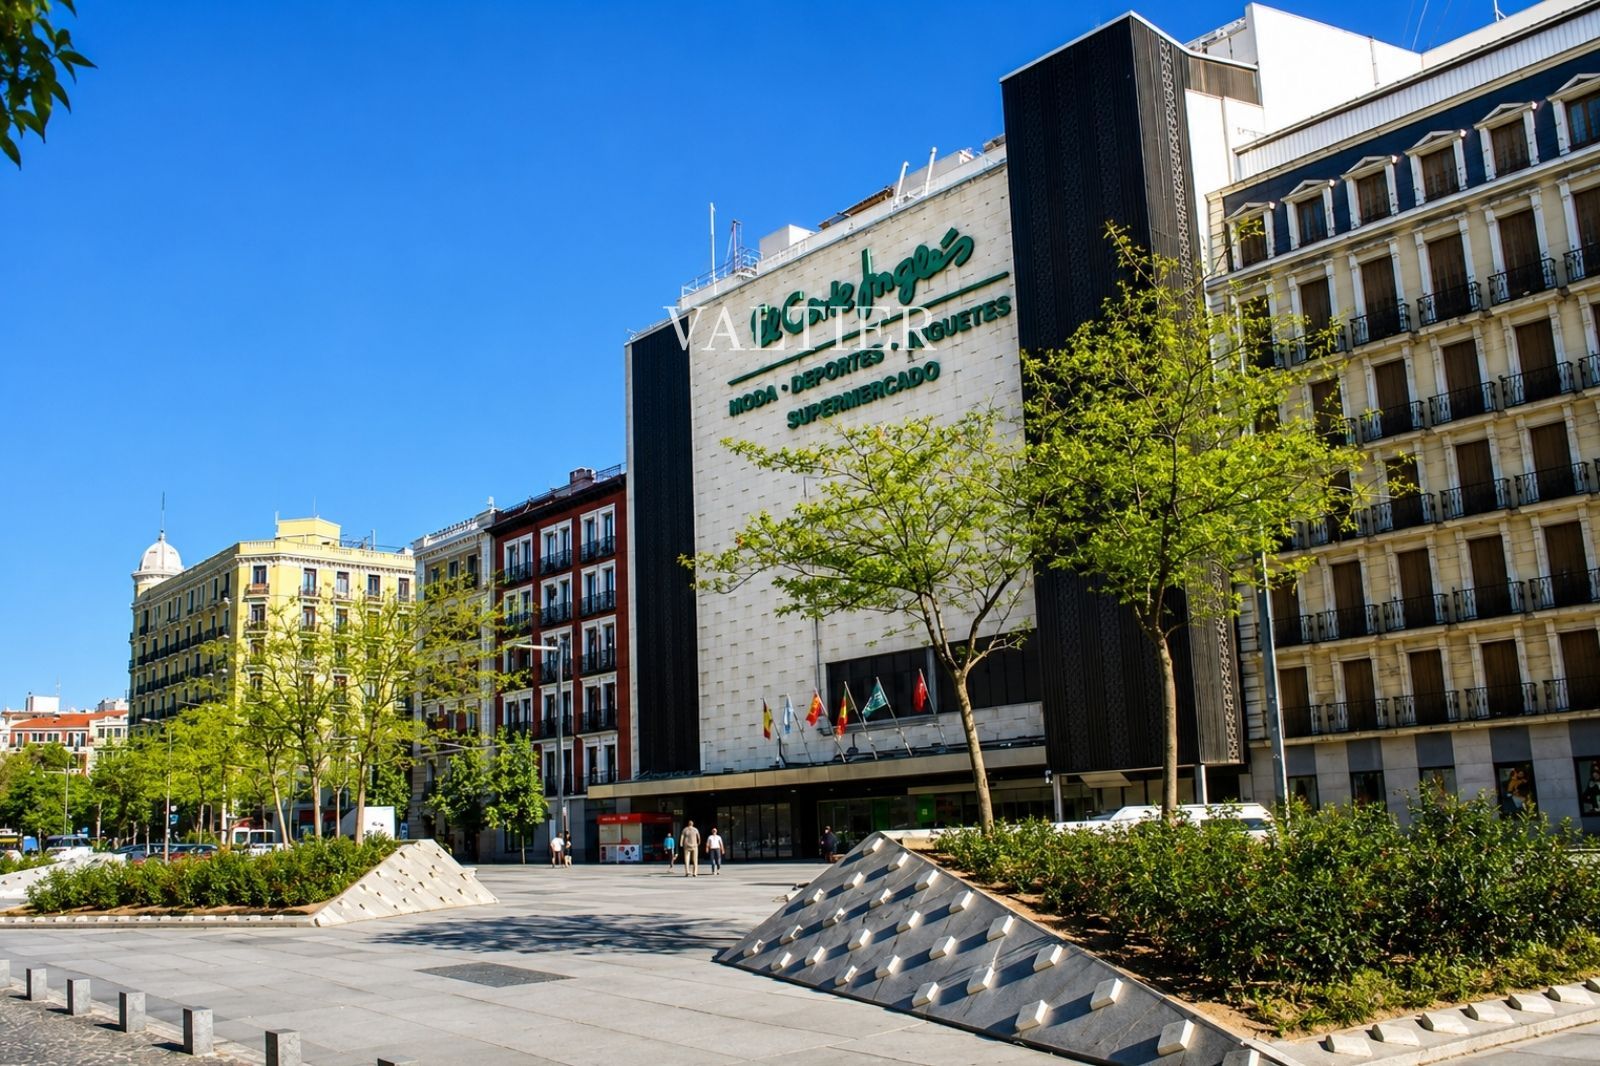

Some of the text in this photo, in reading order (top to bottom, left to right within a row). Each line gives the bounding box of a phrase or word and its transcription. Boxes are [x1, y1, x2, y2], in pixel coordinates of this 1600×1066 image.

[750, 227, 975, 348] El Corte Inglés
[728, 384, 779, 417] MODA
[791, 343, 885, 394] DEPORTES
[787, 360, 941, 430] SUPERMERCADO
